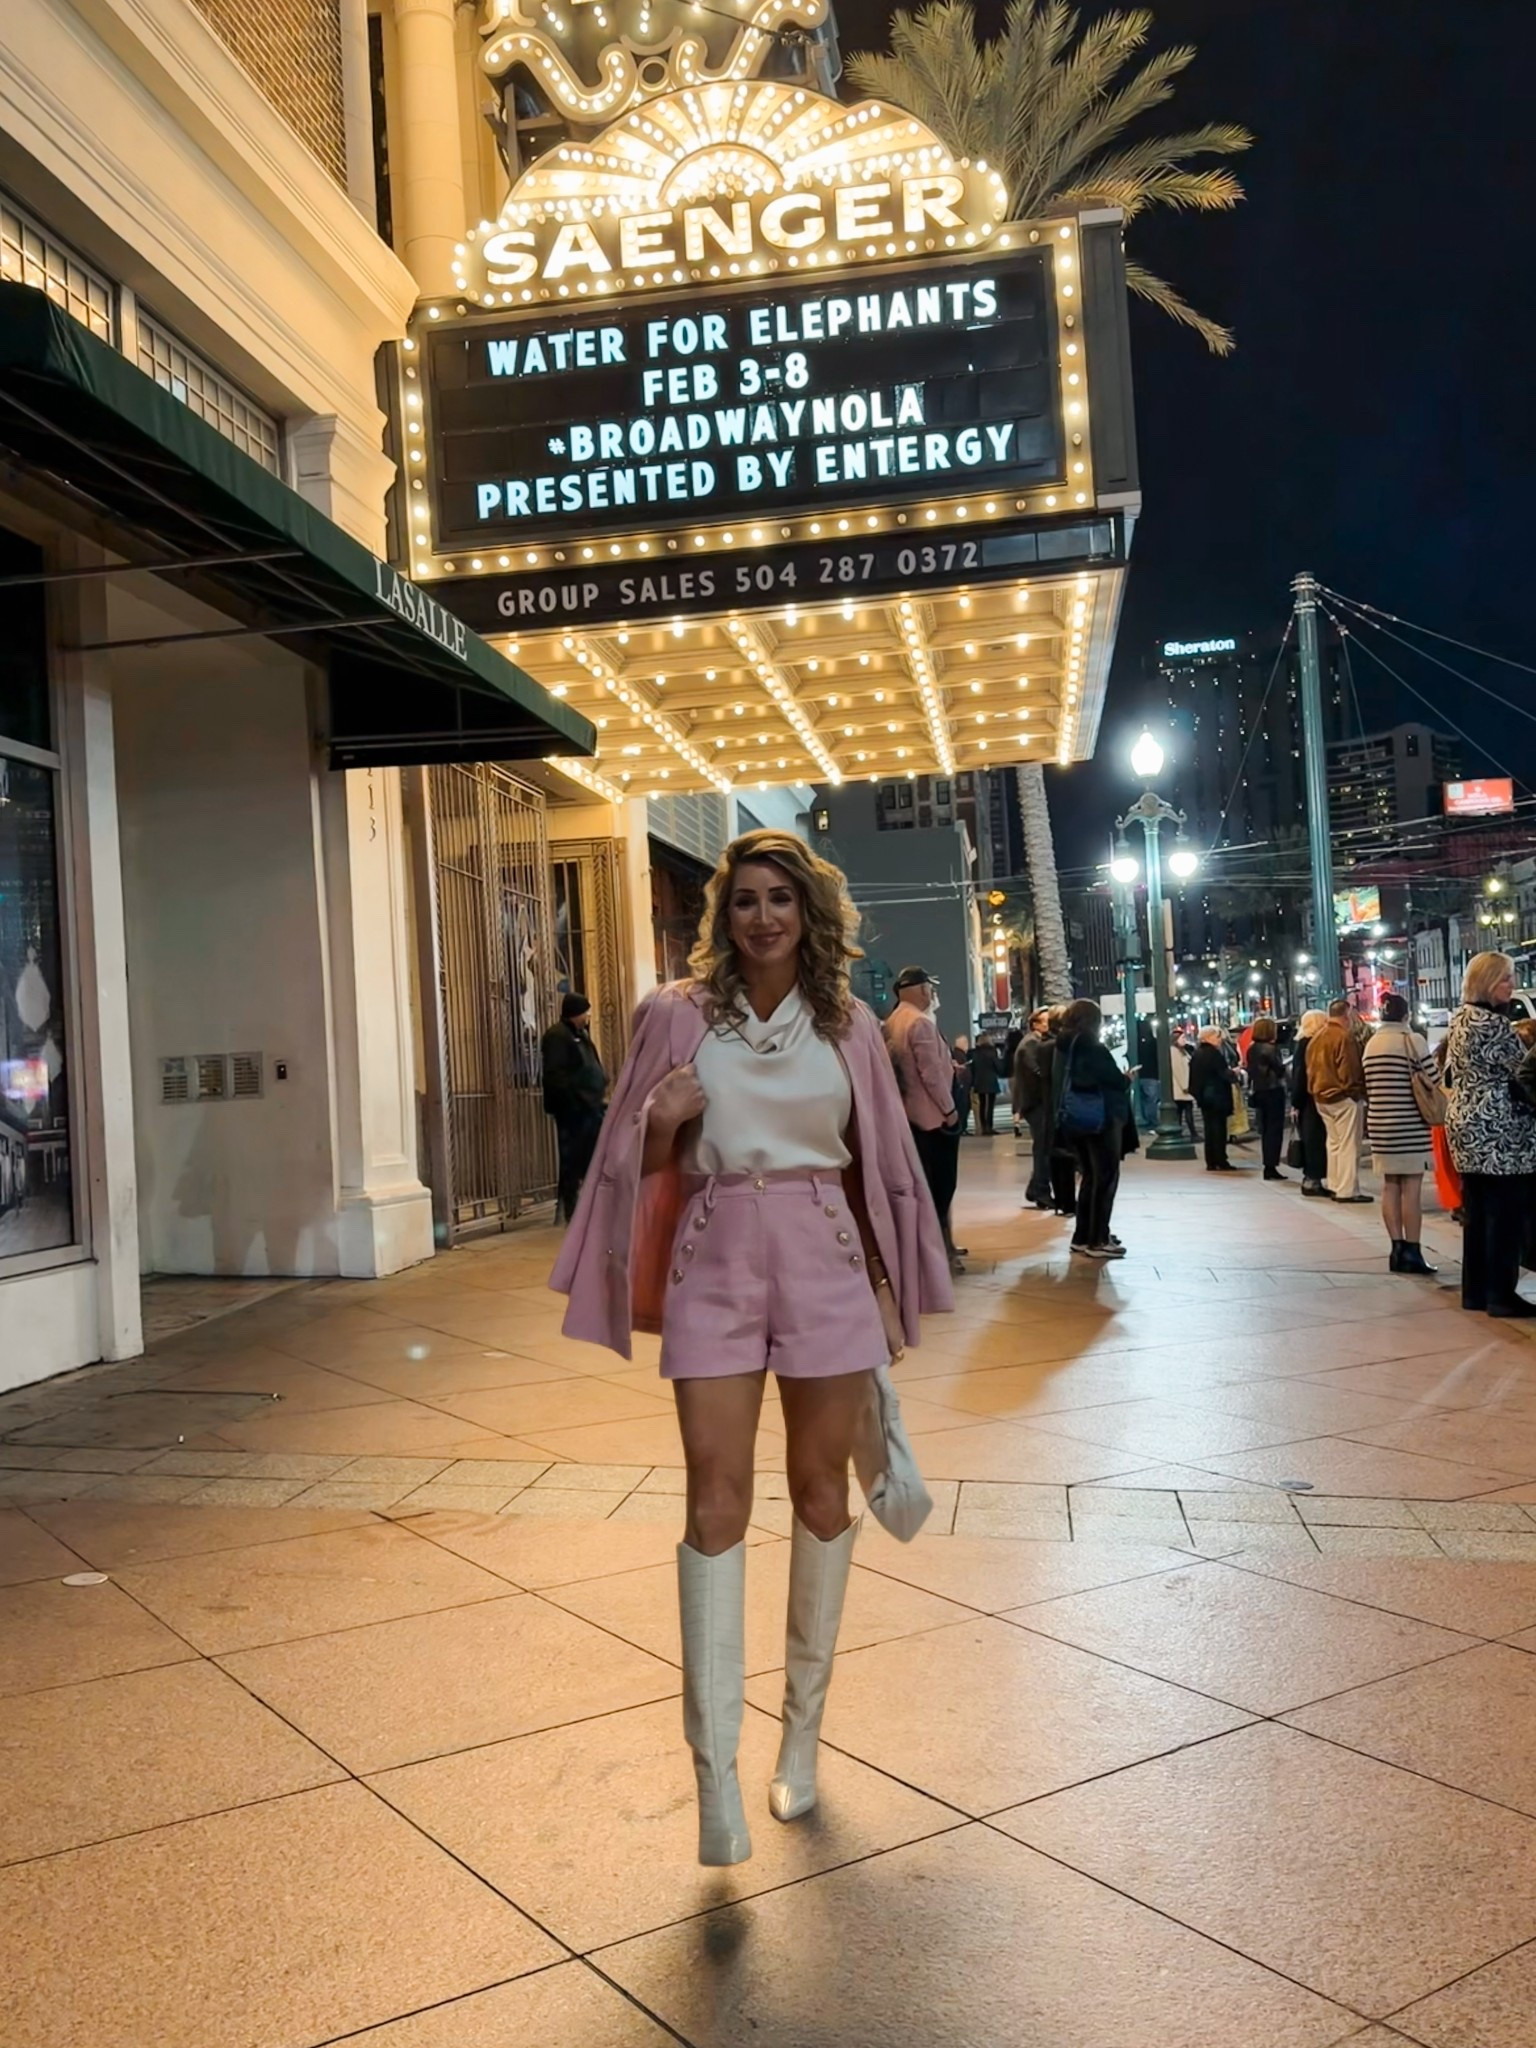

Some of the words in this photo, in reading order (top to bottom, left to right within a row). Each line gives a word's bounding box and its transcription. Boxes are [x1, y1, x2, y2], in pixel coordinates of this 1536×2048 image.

[483, 174, 968, 285] SAENGER
[488, 327, 627, 376] WATER
[647, 314, 729, 358] FOR
[749, 279, 997, 346] ELEPHANTS
[643, 364, 719, 406] FEB
[739, 352, 809, 395] 3-8
[548, 386, 925, 462] #BROADWAYNOLA
[477, 461, 716, 519] PRESENTED
[737, 450, 794, 491] BY
[816, 423, 1014, 483] ENTERGY
[373, 556, 467, 661] LASALLE
[497, 583, 599, 617] GROUP
[619, 570, 716, 605] SALES
[736, 561, 797, 592] 504
[819, 553, 875, 583] 287
[897, 541, 978, 575] 0372
[1164, 639, 1236, 656] Sheraton
